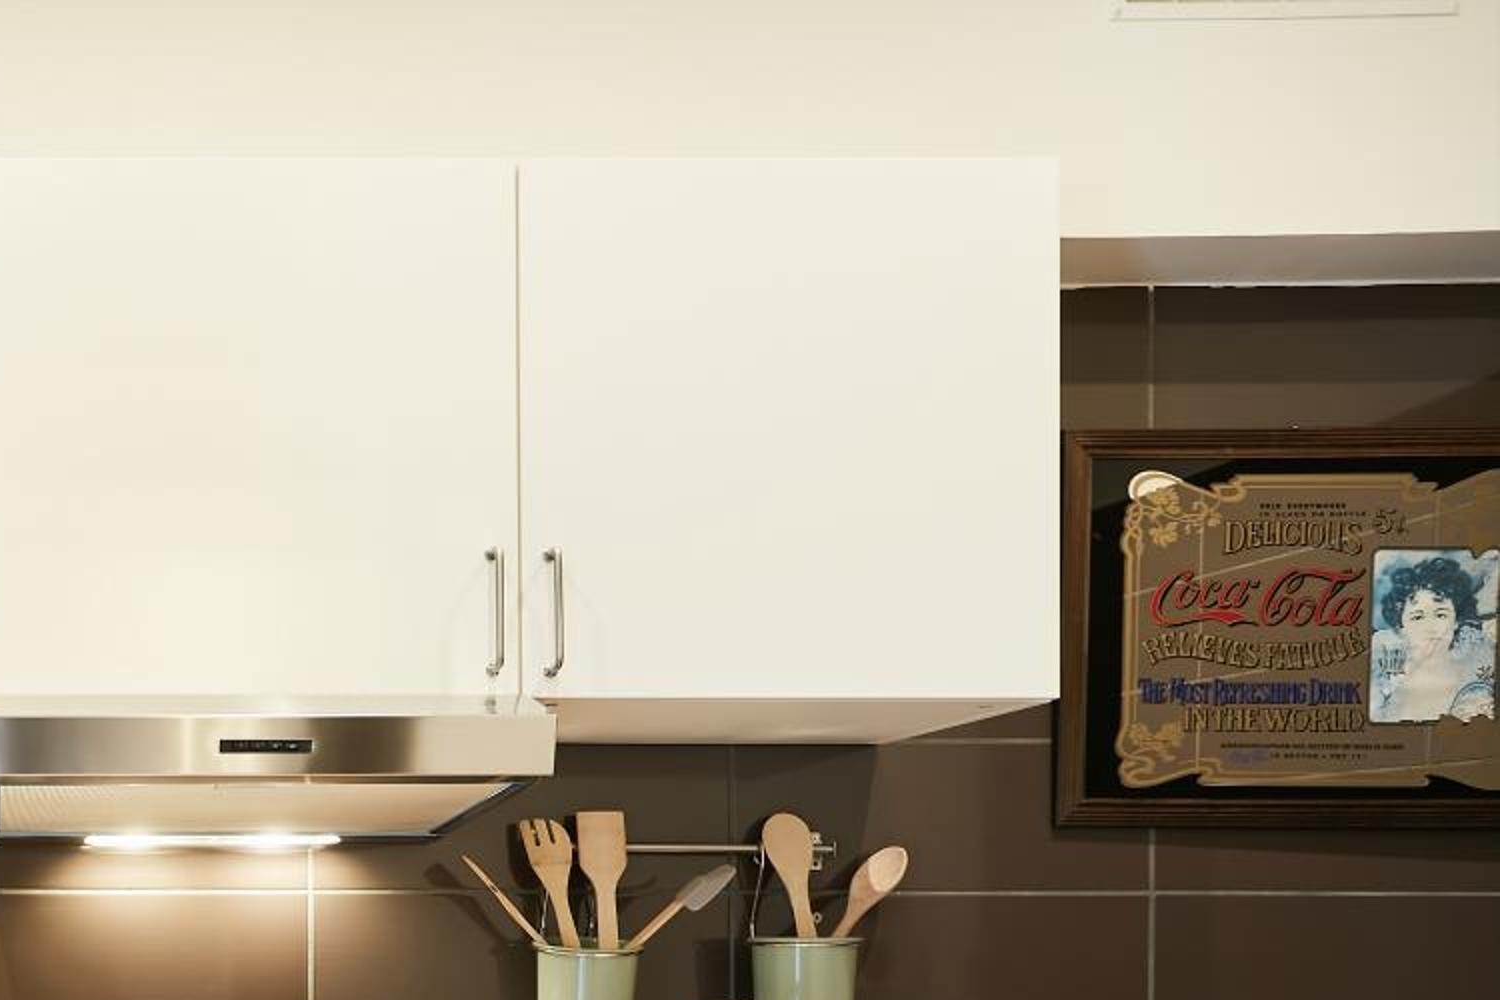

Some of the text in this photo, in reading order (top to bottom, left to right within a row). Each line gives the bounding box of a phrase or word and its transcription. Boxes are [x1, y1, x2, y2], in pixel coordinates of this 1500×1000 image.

[1224, 519, 1363, 556] DELICIOUS
[1150, 567, 1366, 628] Coca-Cola
[1141, 630, 1260, 669] RELIEVES
[1183, 706, 1365, 732] IN THE WORLD
